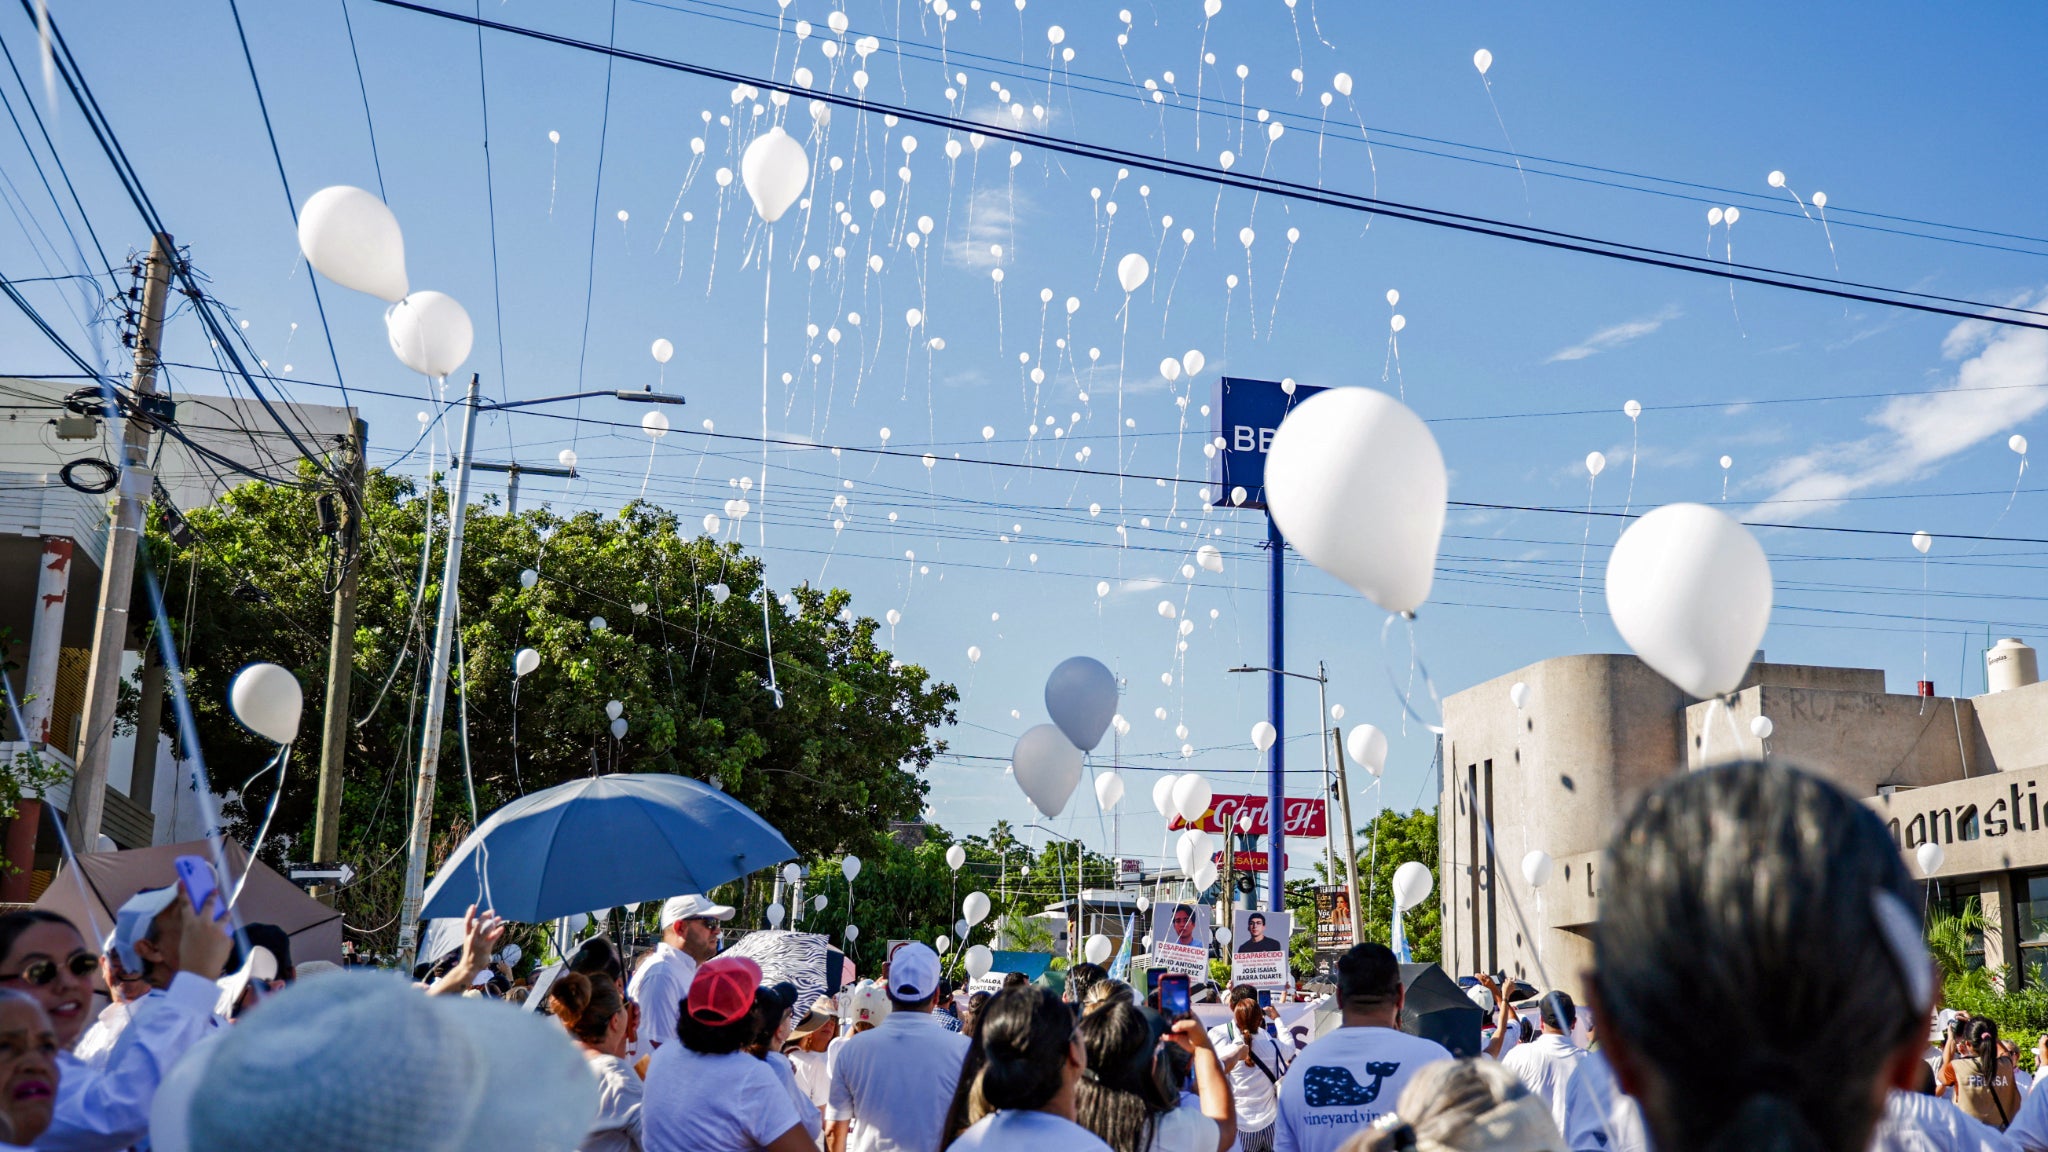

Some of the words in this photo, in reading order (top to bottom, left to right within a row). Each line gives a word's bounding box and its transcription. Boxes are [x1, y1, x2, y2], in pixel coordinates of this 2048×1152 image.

[1284, 802, 1319, 832] Jr.
[1158, 943, 1206, 956] DESAPARECIDO
[1234, 951, 1283, 960] DESAPARECIDO
[1175, 960, 1204, 970] ANTONIO
[1304, 1109, 1358, 1128] vineyard
